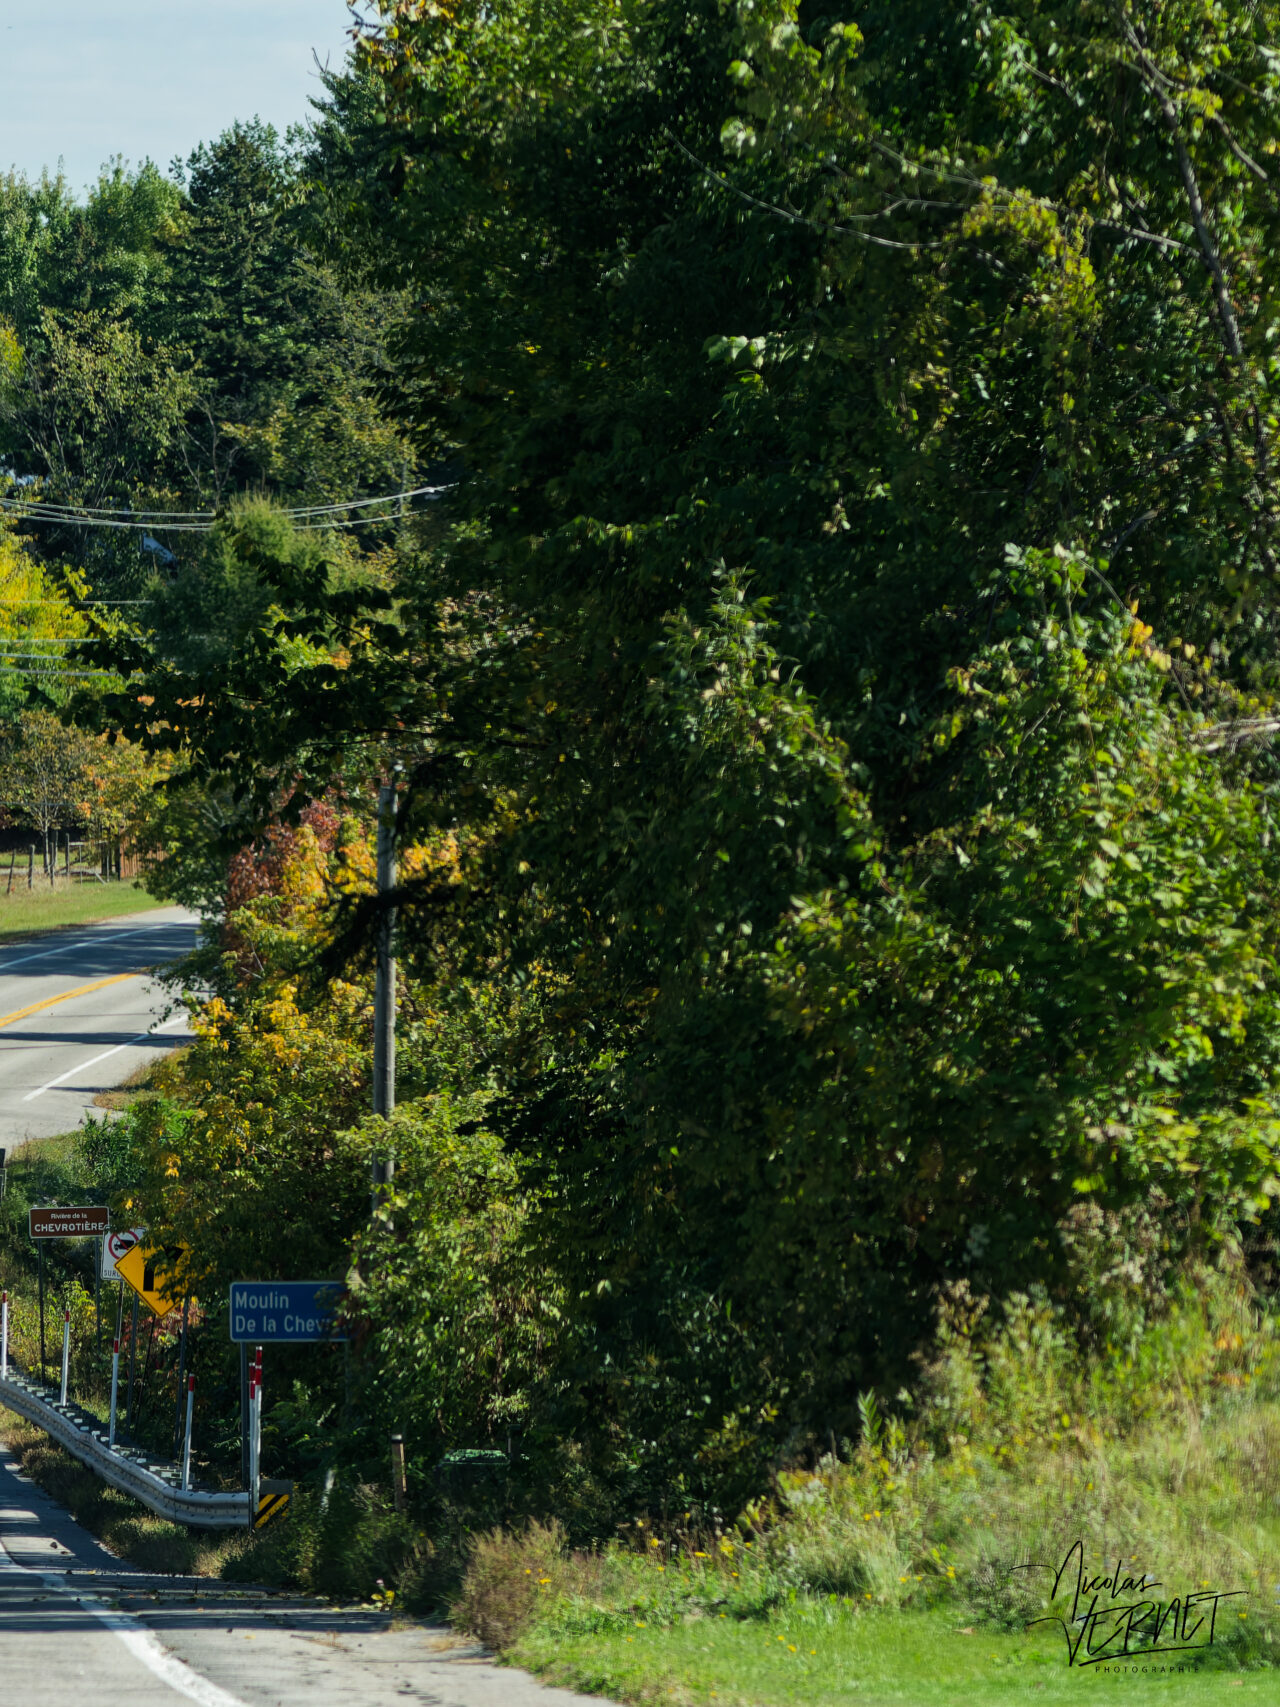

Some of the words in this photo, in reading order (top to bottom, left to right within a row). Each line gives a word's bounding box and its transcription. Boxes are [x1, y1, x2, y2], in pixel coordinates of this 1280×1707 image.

[34, 1221, 104, 1232] CHEVROTIÈRE
[235, 1291, 289, 1309] Moulin
[235, 1315, 256, 1333] De
[263, 1315, 276, 1333] la
